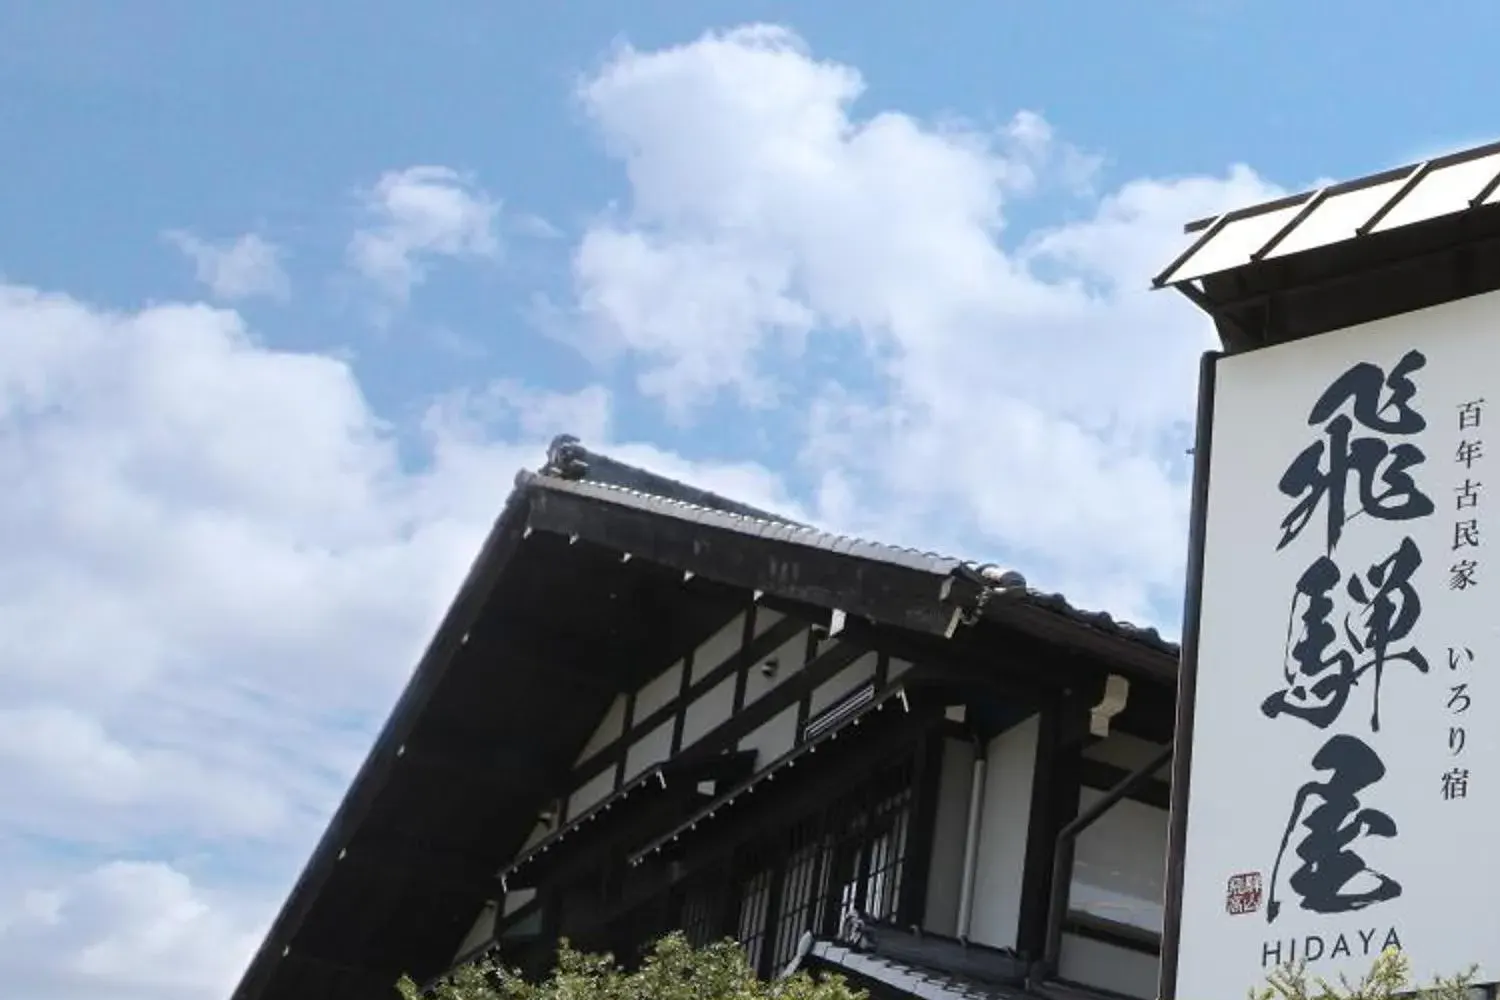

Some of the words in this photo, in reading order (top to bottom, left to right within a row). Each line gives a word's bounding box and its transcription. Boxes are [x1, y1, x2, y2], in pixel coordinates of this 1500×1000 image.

[1448, 397, 1486, 592] 百年古民家
[1260, 348, 1435, 925] 飛騨屋
[1440, 645, 1475, 801] いろり宿
[1261, 926, 1402, 967] HIDAYA
